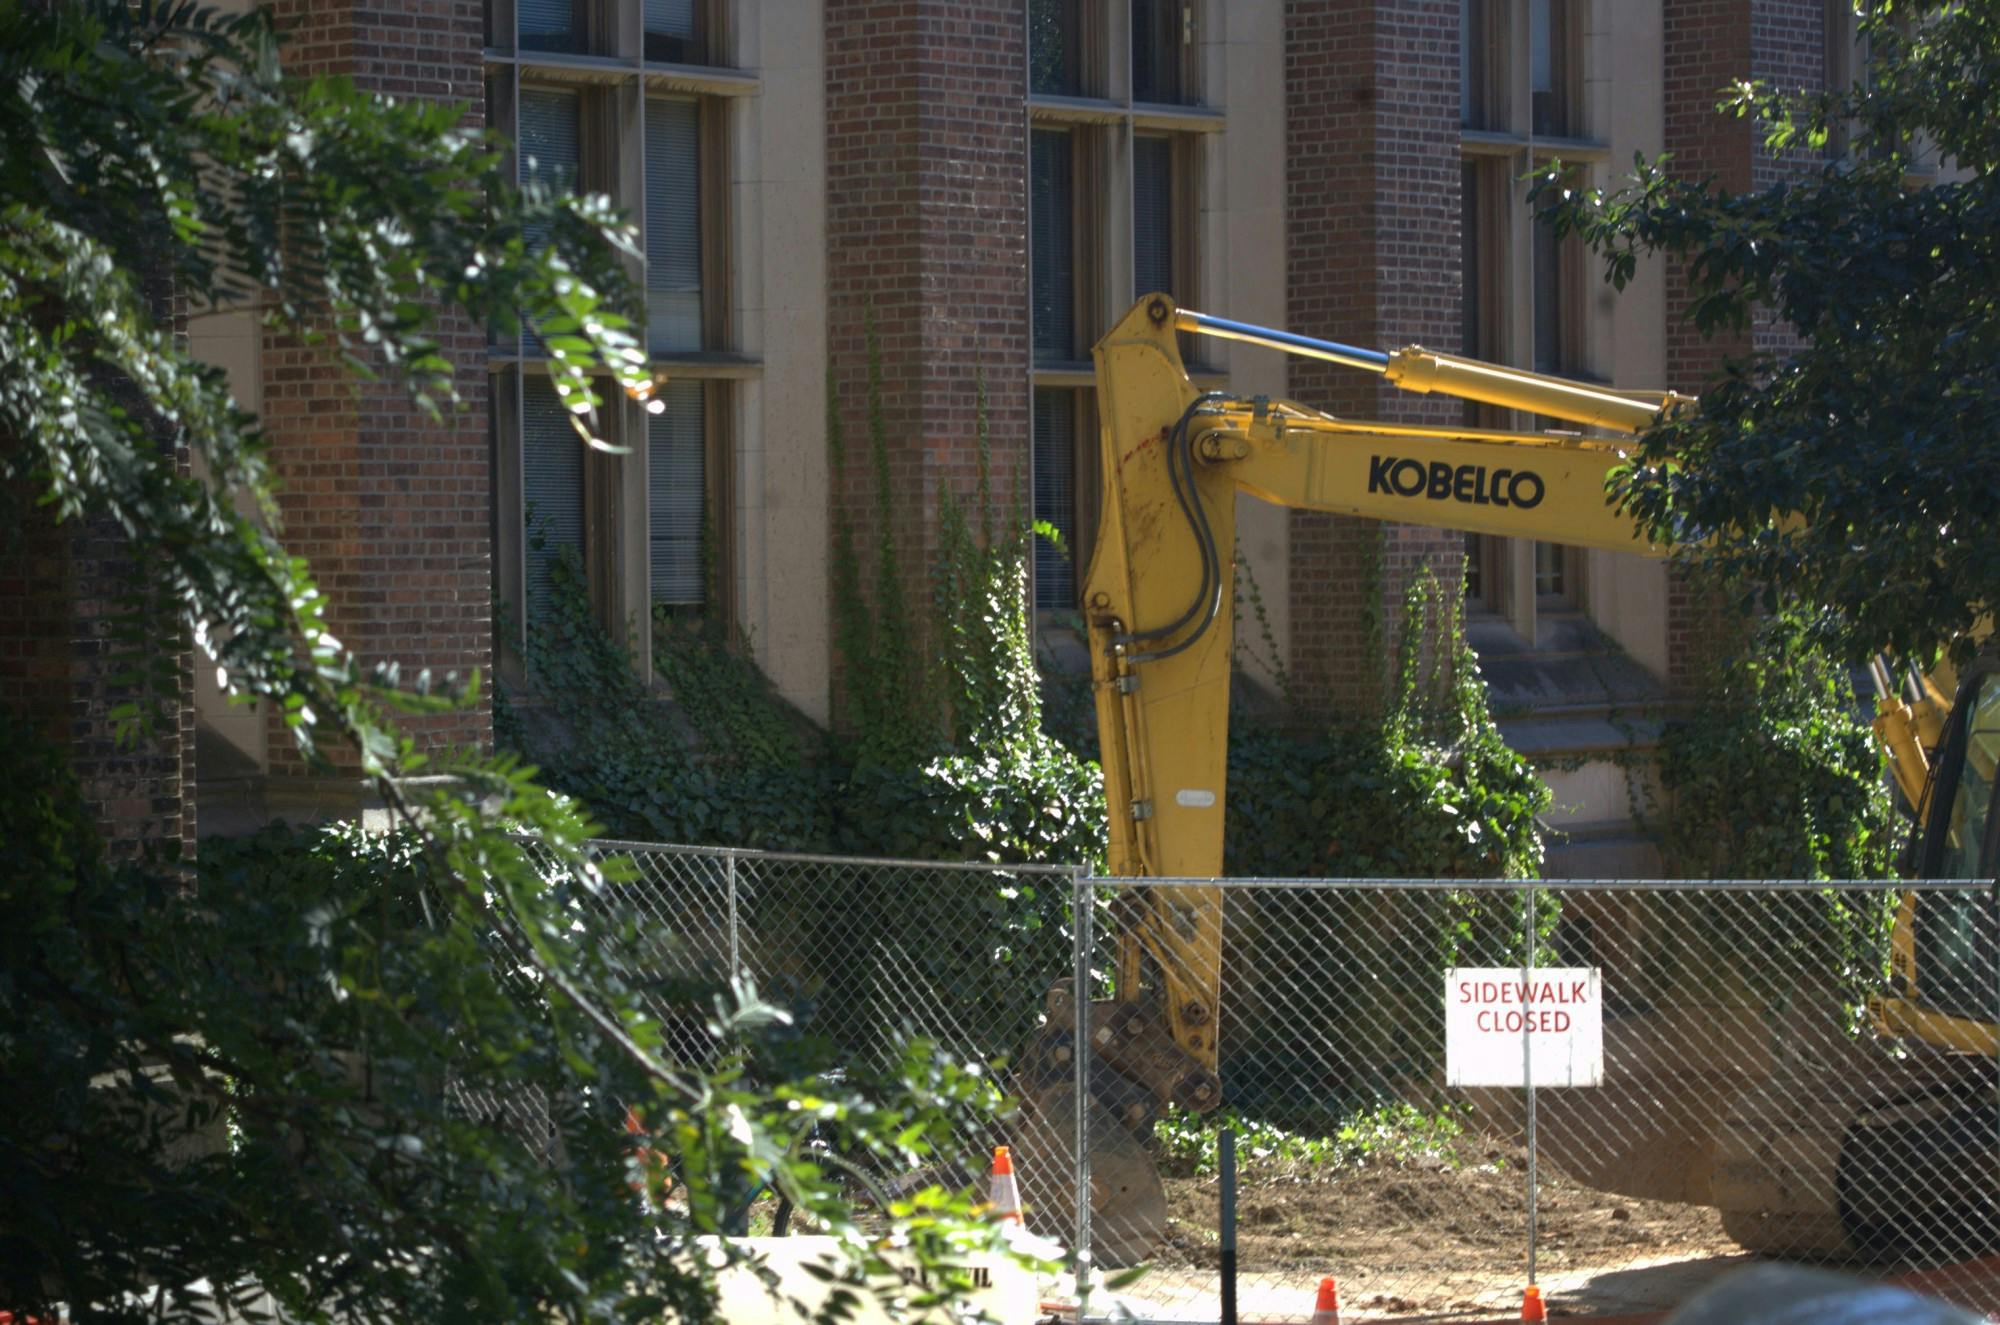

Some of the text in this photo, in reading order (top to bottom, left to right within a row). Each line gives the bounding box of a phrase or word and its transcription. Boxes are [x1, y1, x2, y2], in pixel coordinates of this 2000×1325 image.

[1368, 455, 1545, 509] KOBELCO
[1459, 981, 1587, 1004] SIDEWALK
[1477, 1010, 1571, 1033] CLOSED
